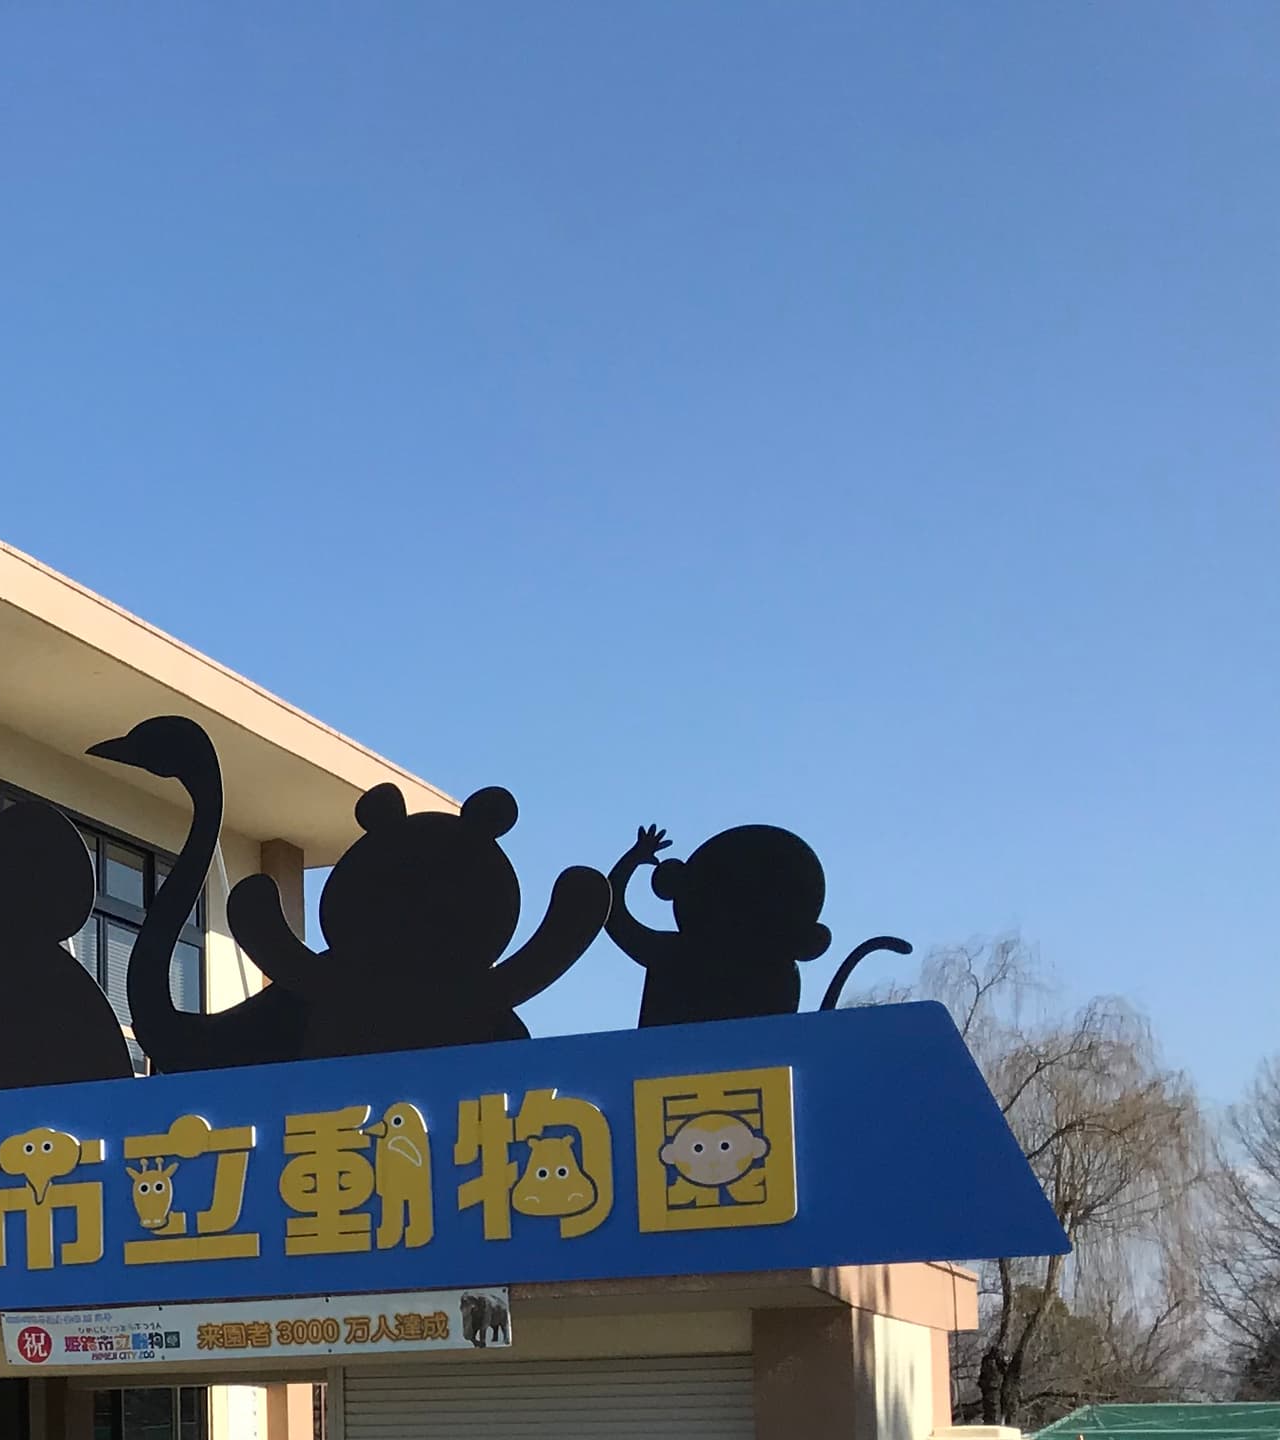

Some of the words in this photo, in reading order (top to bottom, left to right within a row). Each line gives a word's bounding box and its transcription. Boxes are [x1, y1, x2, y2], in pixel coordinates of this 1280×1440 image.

[24, 1331, 49, 1359] 祝
[64, 1331, 181, 1353] 姫路市立動物園
[119, 1350, 137, 1361] CITY
[138, 1350, 155, 1360] ZOO
